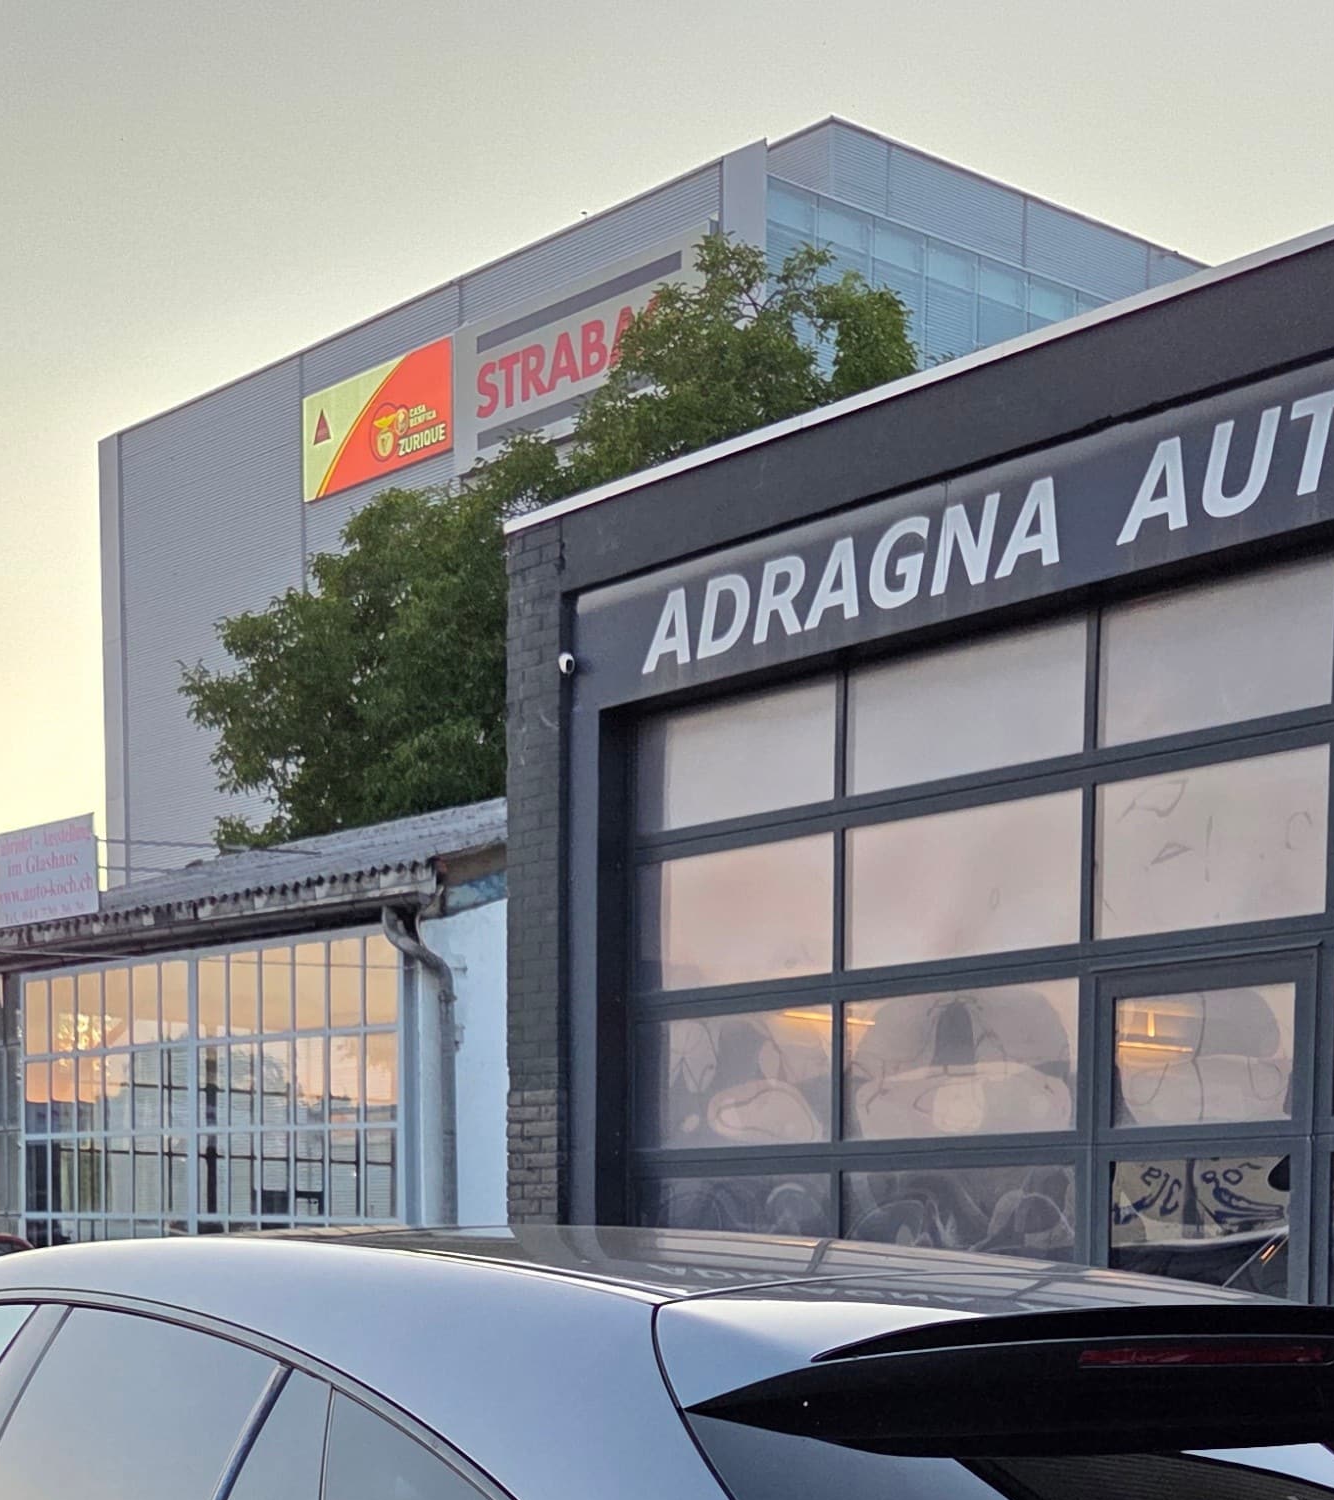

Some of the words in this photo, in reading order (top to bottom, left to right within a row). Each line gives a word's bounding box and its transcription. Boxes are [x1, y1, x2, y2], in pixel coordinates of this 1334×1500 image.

[475, 291, 662, 419] STRABA
[398, 423, 446, 456] ZURIQUE
[641, 476, 1060, 675] ADRAGNA
